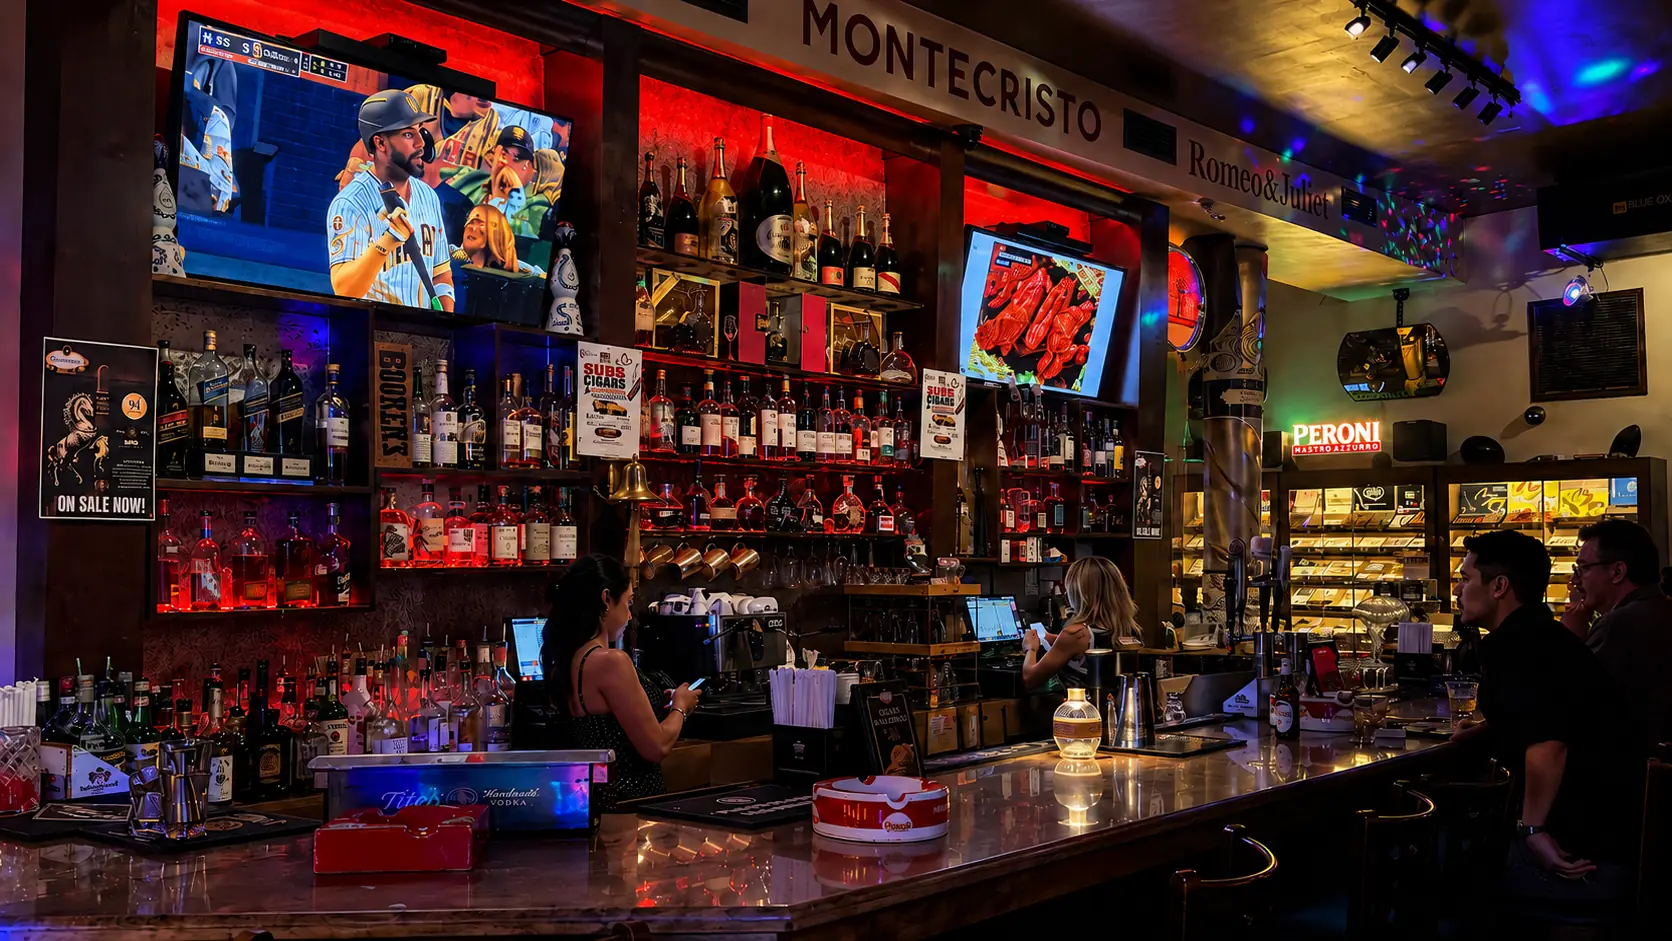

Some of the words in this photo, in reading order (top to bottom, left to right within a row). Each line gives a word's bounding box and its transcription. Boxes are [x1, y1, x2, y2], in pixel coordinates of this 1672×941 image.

[803, 0, 1101, 142] MONTECRISTO
[1189, 139, 1329, 220] Romeo&Juliet
[1628, 196, 1654, 209] BLUE
[583, 362, 626, 379] SUBS
[583, 374, 626, 390] CIGARS
[128, 399, 141, 411] 94
[1292, 421, 1381, 446] PERONI
[57, 494, 76, 512] ON
[78, 495, 110, 513] SALE
[112, 496, 146, 514] NOW!
[490, 799, 528, 807] VODKA
